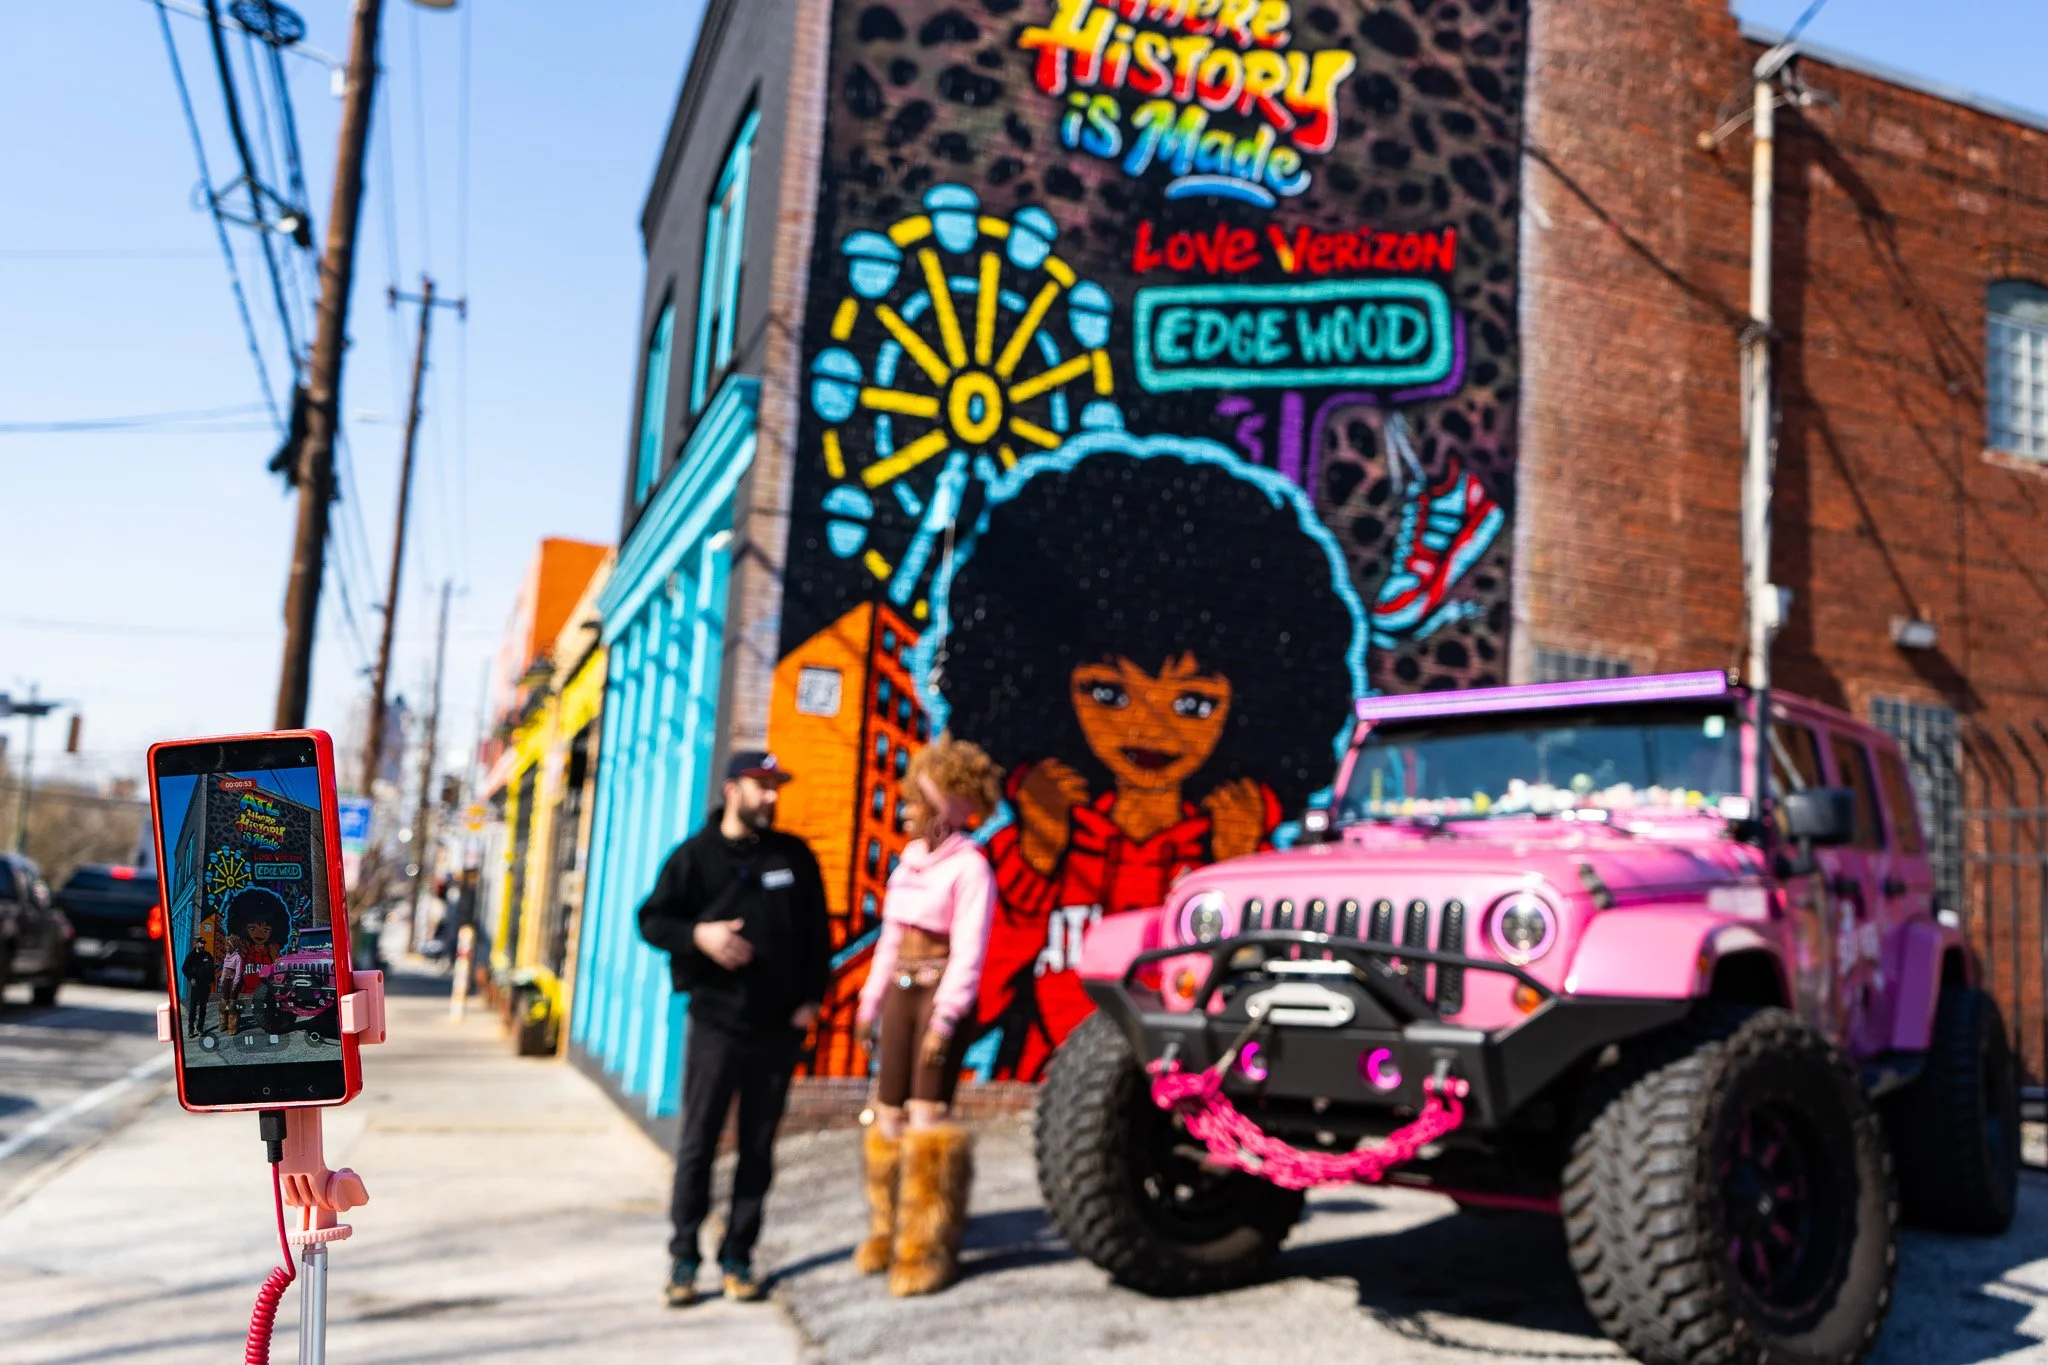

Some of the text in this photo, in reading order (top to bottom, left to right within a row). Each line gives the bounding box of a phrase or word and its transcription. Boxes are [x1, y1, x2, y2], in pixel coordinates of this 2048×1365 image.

[1122, 100, 1312, 197] Made
[225, 780, 253, 788] 00:00:53
[240, 790, 280, 816] ATL
[253, 833, 281, 850] Made
[1033, 904, 1104, 979] AT
